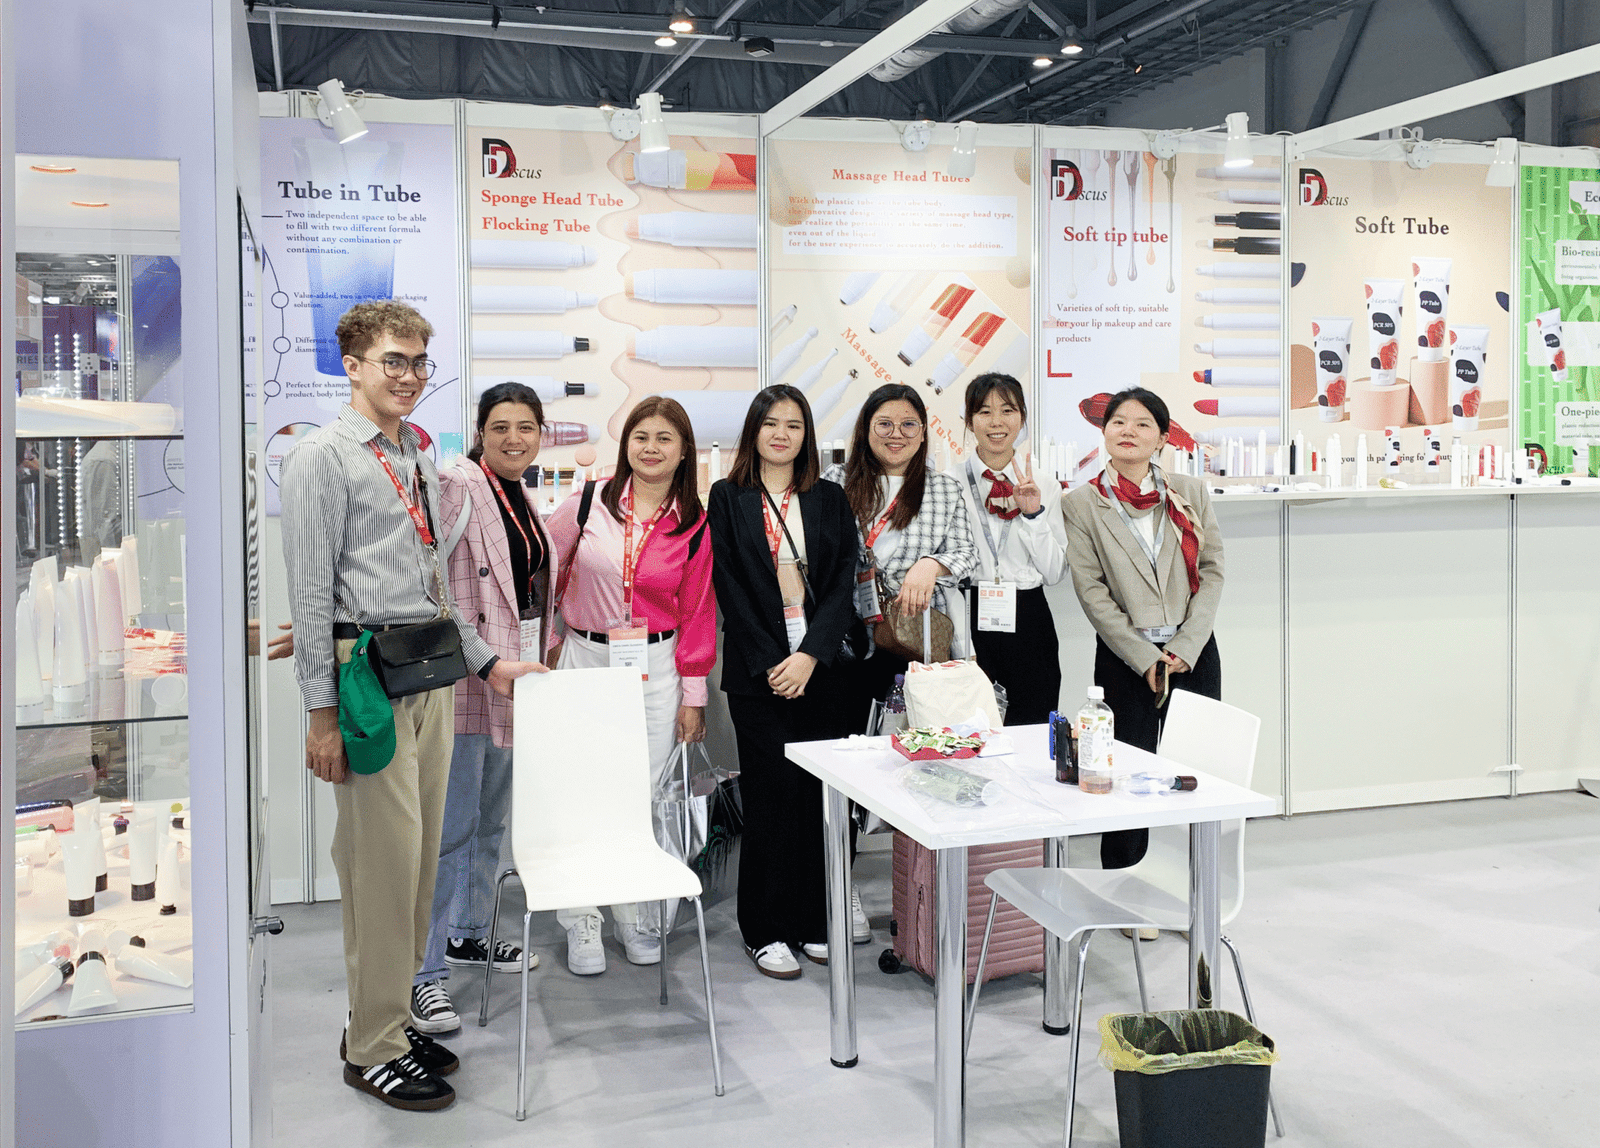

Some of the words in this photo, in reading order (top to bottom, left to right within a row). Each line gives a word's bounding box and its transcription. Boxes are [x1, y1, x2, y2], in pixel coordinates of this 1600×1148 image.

[832, 169, 888, 184] Massage
[893, 171, 927, 182] Head
[278, 181, 333, 199] Tube
[340, 183, 360, 201] in
[368, 184, 421, 203] Tube
[1585, 191, 1600, 202] Ec
[481, 189, 537, 208] Sponge
[542, 192, 582, 206] Head
[587, 193, 624, 207] Tube
[811, 197, 824, 205] the
[827, 197, 854, 206] plastic
[285, 210, 305, 218] Two
[307, 210, 359, 221] independent
[362, 214, 385, 222] space
[397, 213, 407, 221] be
[410, 213, 427, 222] able
[804, 207, 847, 216] innovative
[939, 212, 970, 220] massage
[973, 210, 992, 218] head
[994, 211, 1014, 220] type,
[297, 221, 308, 230] fill
[311, 222, 330, 230] with
[350, 223, 387, 232] different
[389, 224, 421, 233] formula
[482, 217, 549, 235] Flocking
[553, 219, 591, 233] Tube
[805, 218, 833, 226] realize
[836, 218, 848, 226] the
[1355, 215, 1396, 234] Soft
[1403, 217, 1450, 235] Tube
[286, 233, 319, 242] without
[339, 235, 391, 244] combination
[837, 229, 849, 237] the
[1063, 226, 1099, 242] Soft
[1104, 227, 1127, 247] tip
[1132, 227, 1168, 243] tube
[286, 245, 350, 254] contamination.
[789, 239, 801, 247] for
[804, 239, 817, 247] the
[968, 241, 1004, 249] addition.
[1057, 303, 1093, 312] Varieties
[1095, 303, 1104, 312] of
[1105, 303, 1120, 312] soft
[1122, 304, 1136, 314] tip,
[1138, 304, 1169, 313] suitable
[1056, 319, 1069, 328] for
[1069, 320, 1090, 329] your
[1091, 319, 1102, 329] lip
[1104, 319, 1136, 329] makeup
[1138, 319, 1153, 328] and
[1056, 334, 1091, 344] products
[841, 327, 892, 382] Massage
[324, 381, 351, 389] shampo
[285, 390, 315, 399] product,
[316, 390, 333, 399] body
